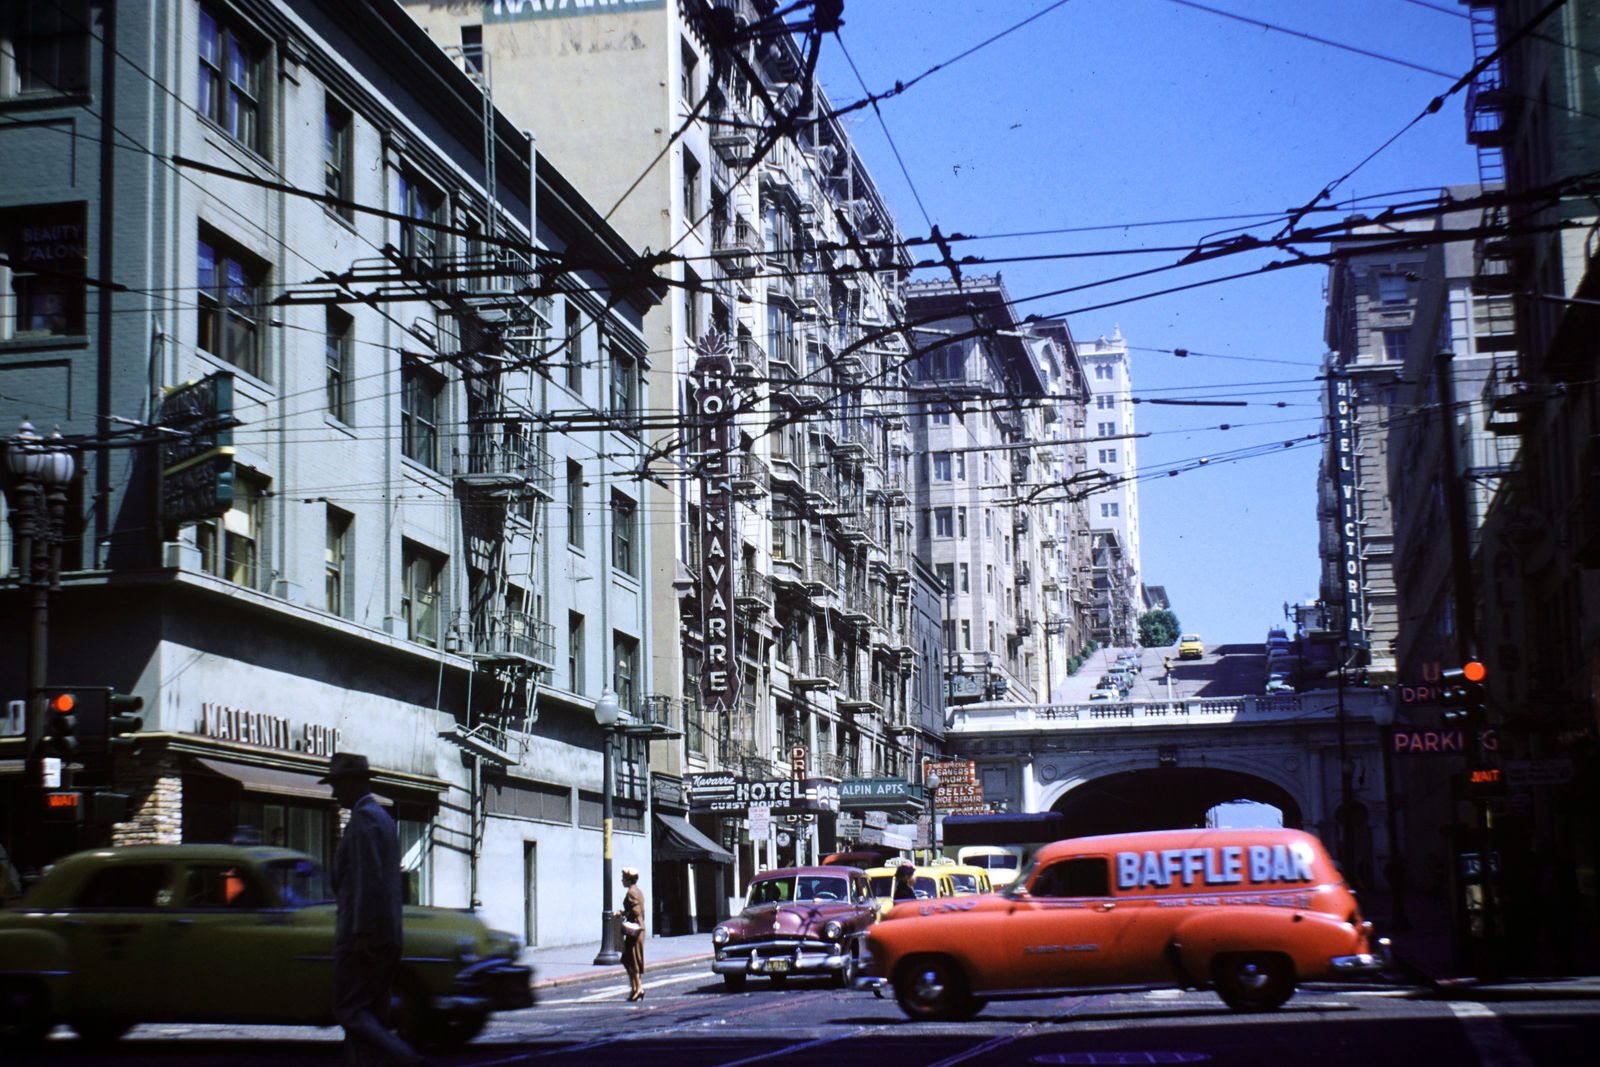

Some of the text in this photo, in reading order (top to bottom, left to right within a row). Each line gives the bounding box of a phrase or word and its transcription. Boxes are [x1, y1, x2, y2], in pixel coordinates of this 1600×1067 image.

[24, 225, 82, 243] BEAUTY
[22, 244, 83, 261] SALON
[1337, 382, 1360, 632] HOTEL VICTORIA
[706, 512, 728, 692] NAVARRE
[1493, 550, 1520, 702] ALIBI
[1422, 661, 1440, 683] U
[1401, 685, 1463, 702] DRI
[203, 702, 342, 757] MATERNITY SHOP
[1394, 729, 1497, 753] PARKIG
[927, 767, 969, 776] CEANERS
[939, 775, 968, 784] UNDRY
[1470, 769, 1500, 783] WAIT
[693, 775, 736, 787] Navarre
[842, 784, 905, 795] ALPIN APTS.
[737, 781, 805, 801] HOTEL
[935, 795, 982, 804] SHOE REPAIR
[938, 786, 975, 796] BELL'S
[50, 794, 78, 806] WAIT
[710, 800, 790, 810] GUEST HOUSE
[1116, 843, 1315, 888] BAFFLE BAR
